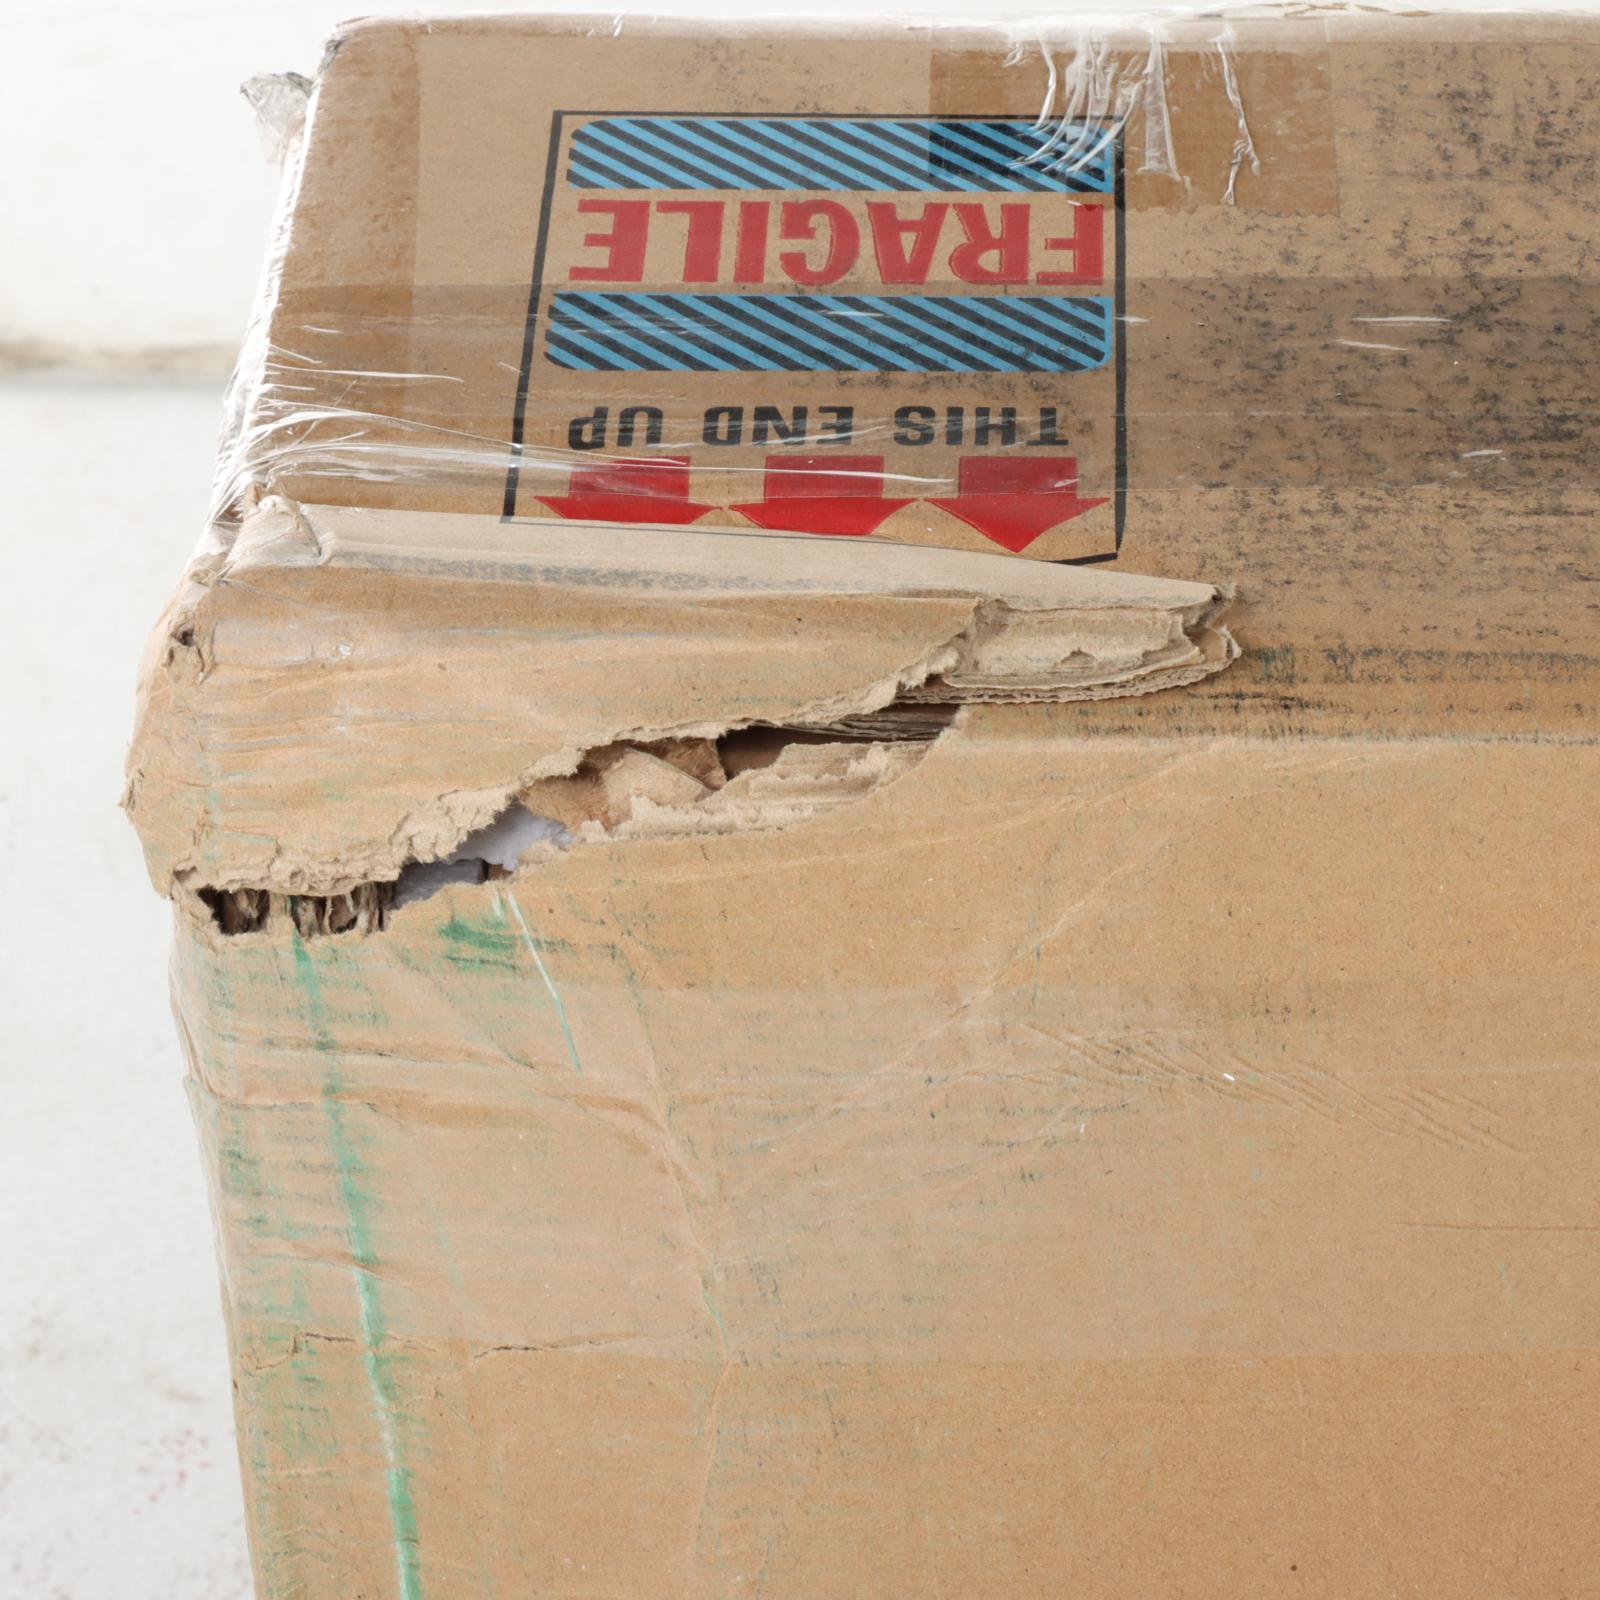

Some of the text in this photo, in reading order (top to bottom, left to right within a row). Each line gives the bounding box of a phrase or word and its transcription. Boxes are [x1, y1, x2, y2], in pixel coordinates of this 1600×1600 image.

[569, 199, 1104, 286] FRAGILE
[568, 405, 1069, 451] THIS END UP
